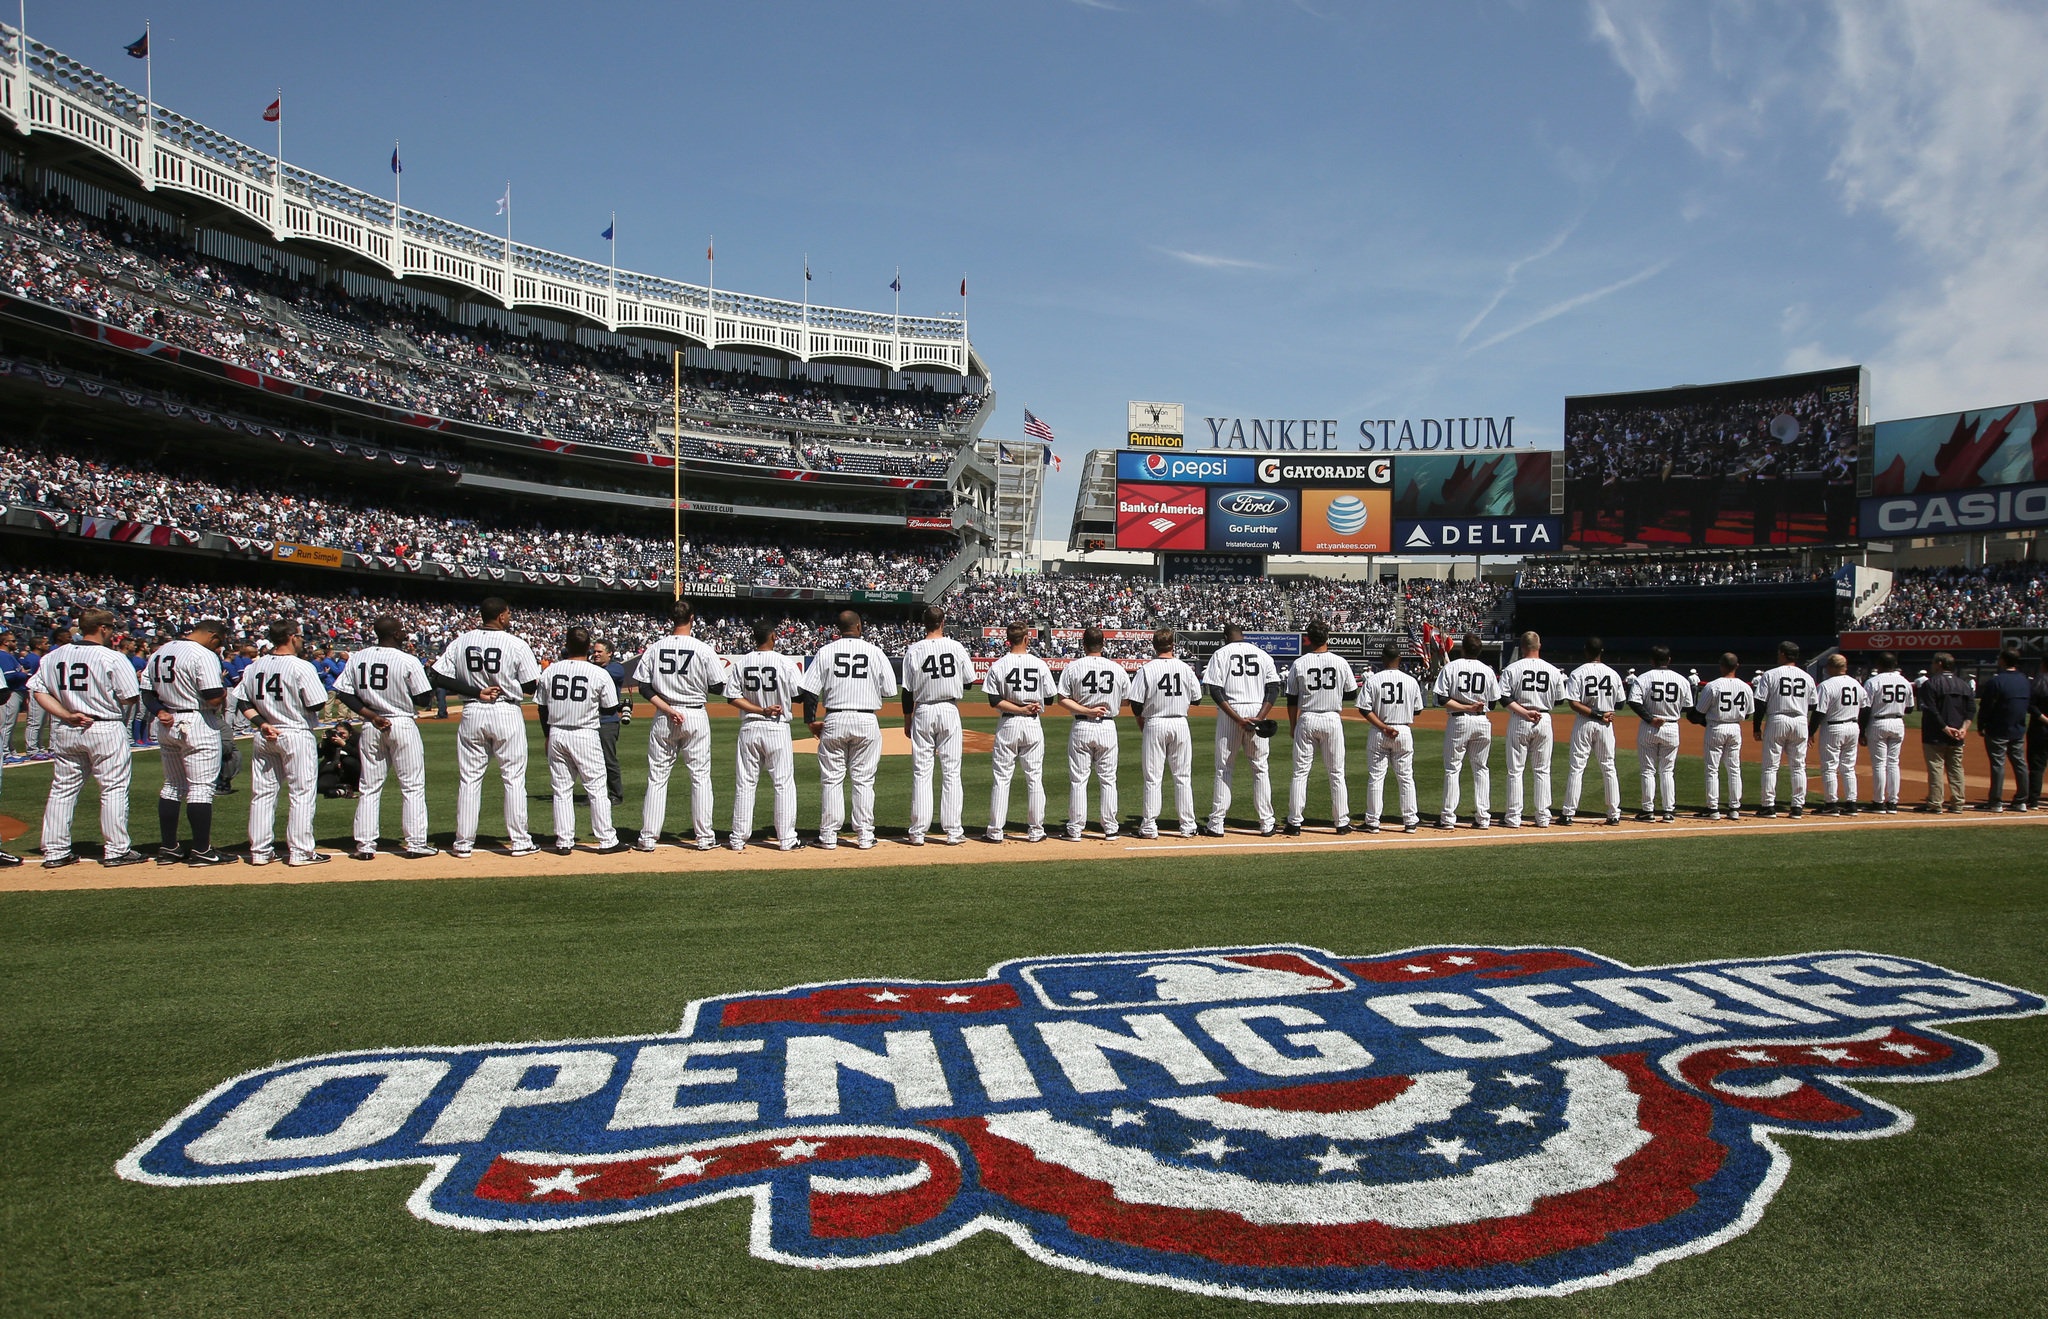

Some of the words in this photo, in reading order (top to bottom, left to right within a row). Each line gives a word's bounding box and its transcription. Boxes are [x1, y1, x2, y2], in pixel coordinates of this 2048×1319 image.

[1130, 433, 1182, 447] Armitron
[1203, 416, 1338, 451] YANKEE
[1358, 415, 1515, 451] STADIUM
[1172, 459, 1227, 479] pepsi
[1282, 465, 1366, 479] GATORADE
[693, 503, 719, 512] YANKEES
[719, 505, 734, 513] CLUB
[1120, 501, 1147, 513] Bank
[1147, 502, 1159, 514] of
[1160, 502, 1204, 515] America
[1231, 494, 1276, 513] Ford
[1878, 486, 2048, 532] CASIO
[908, 519, 951, 528] Budweiser
[1229, 524, 1243, 533] Go
[1244, 524, 1278, 534] Further
[1442, 523, 1551, 545] DELTA
[278, 547, 294, 557] SAP
[297, 549, 312, 559] Run
[313, 551, 338, 563] Simple
[1316, 542, 1377, 551] att.yankees.com
[684, 582, 736, 594] SYRACUSE
[1327, 637, 1362, 645] KOHAMA
[1896, 634, 1963, 646] TOYOTA
[154, 655, 176, 683] 13
[465, 645, 502, 674] 68
[658, 649, 695, 675] 57
[833, 653, 869, 679] 52
[921, 653, 956, 680] 48
[1230, 654, 1260, 677] 35
[56, 661, 89, 691] 12
[255, 672, 284, 700] 14
[357, 662, 389, 691] 18
[743, 666, 777, 692] 53
[1005, 667, 1038, 693] 45
[1082, 670, 1115, 694] 43
[1157, 672, 1183, 697] 41
[1306, 667, 1336, 691] 33
[1457, 671, 1486, 694] 30
[1521, 670, 1550, 693] 29
[1584, 675, 1613, 697] 24
[1779, 676, 1806, 698] 62
[551, 674, 588, 702] 66
[1380, 681, 1404, 705] 31
[1651, 681, 1679, 703] 59
[1840, 686, 1859, 706] 61
[1882, 684, 1907, 703] 56
[1719, 690, 1746, 712] 54
[183, 1003, 1374, 1165] OPENING
[1364, 953, 1998, 1060] SERIES
